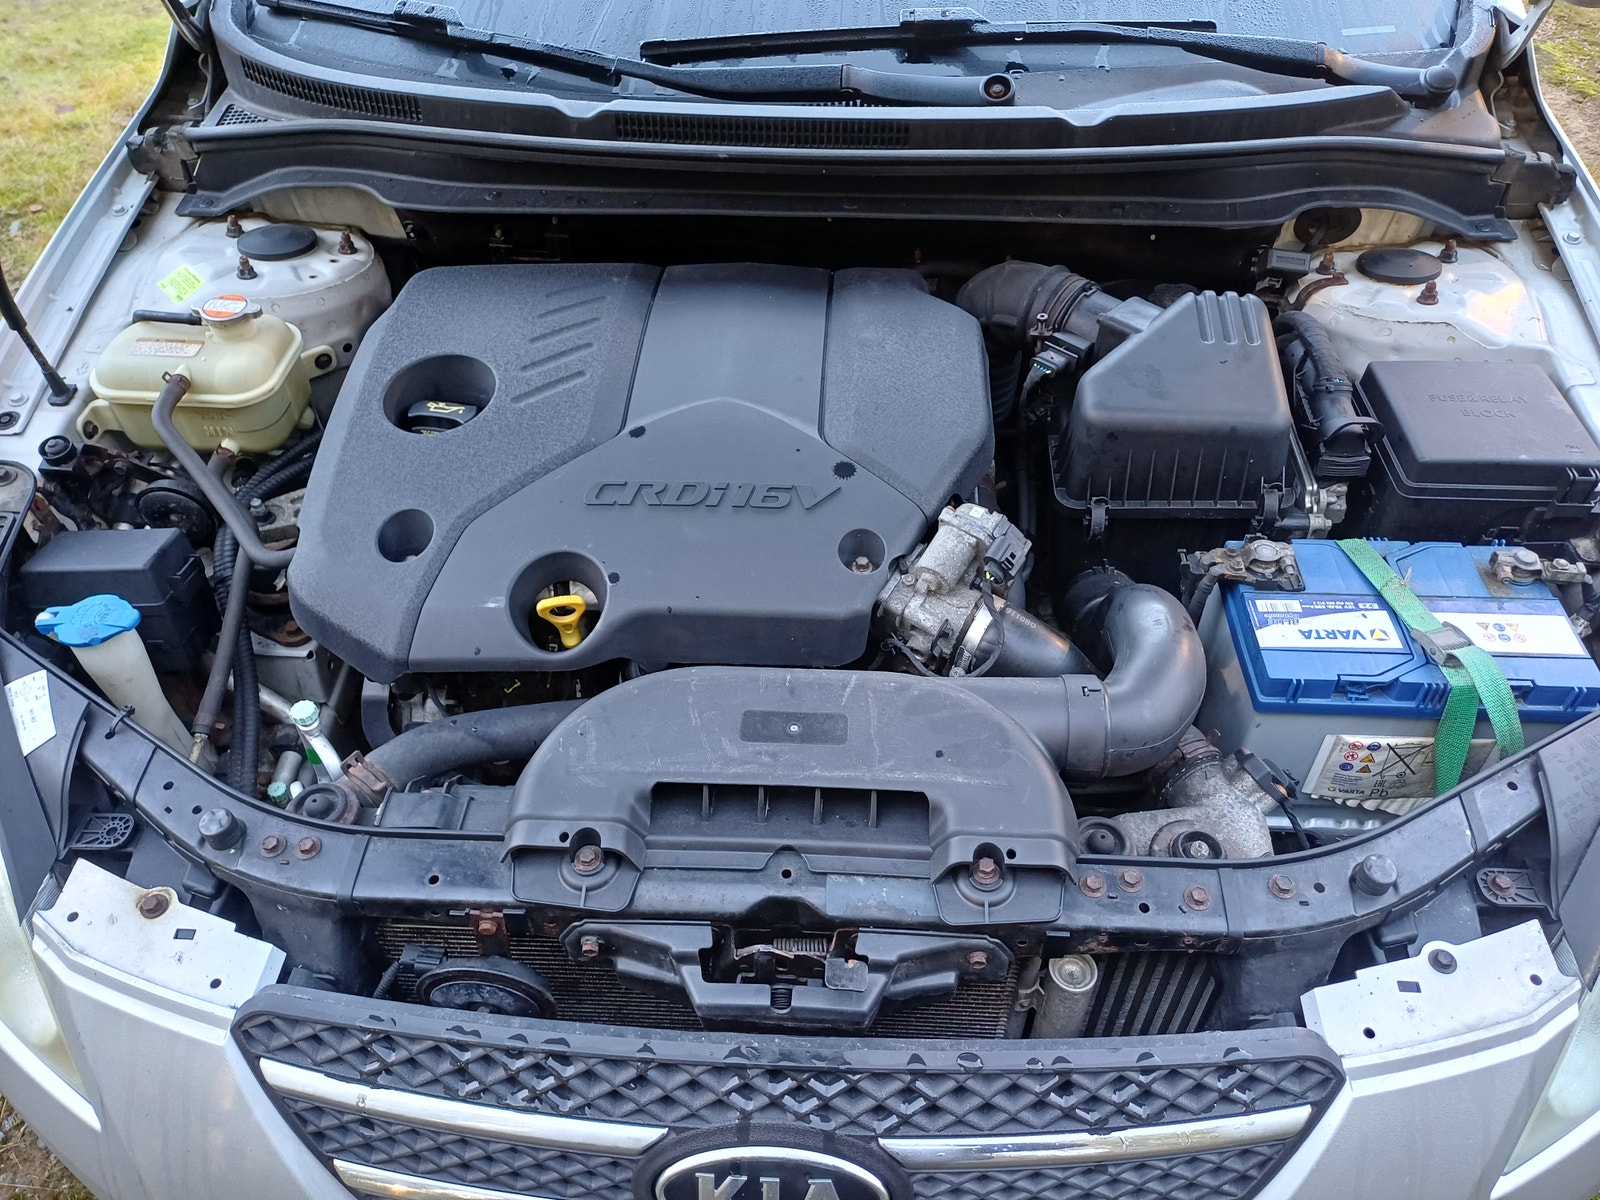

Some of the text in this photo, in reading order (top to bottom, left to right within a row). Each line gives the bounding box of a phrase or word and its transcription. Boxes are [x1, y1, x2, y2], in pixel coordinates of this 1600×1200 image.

[1461, 408, 1516, 418] BLOCK
[203, 425, 235, 437] MIN
[1005, 607, 1037, 628] 080116
[1297, 629, 1367, 640] VARTA
[1369, 789, 1389, 798] Pb
